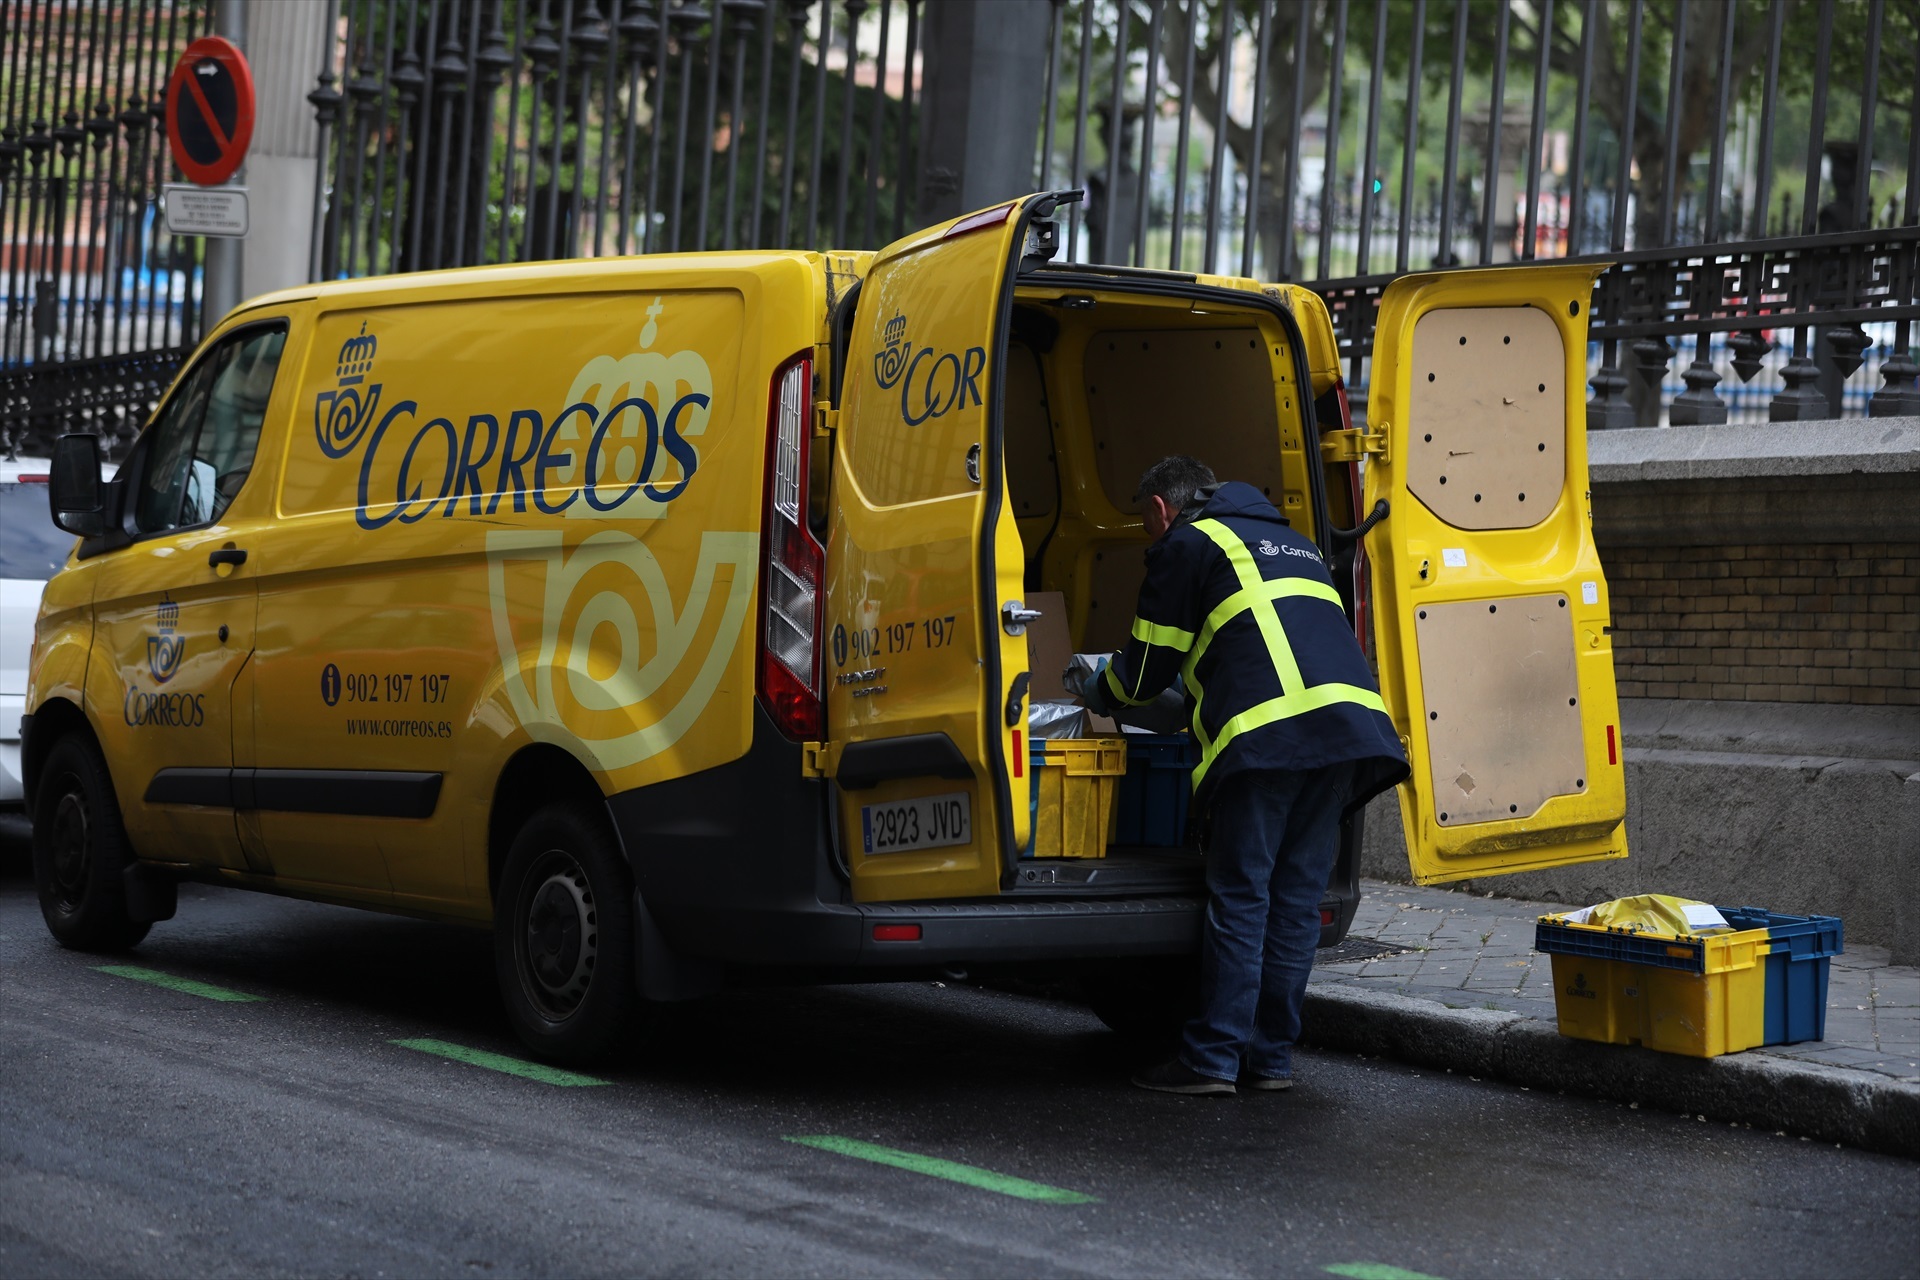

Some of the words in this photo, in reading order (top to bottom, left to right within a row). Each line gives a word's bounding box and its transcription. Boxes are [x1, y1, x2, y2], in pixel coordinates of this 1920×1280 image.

[355, 393, 711, 530] CORREOS
[851, 627, 881, 660] 902
[885, 622, 915, 654] 197
[923, 616, 956, 649] 197
[124, 685, 205, 728] CORREOS
[346, 673, 379, 702] 902
[384, 673, 413, 703] 197
[420, 673, 450, 704] 197
[347, 719, 452, 738] www.correos.es
[876, 805, 920, 848] 2923
[928, 800, 963, 841] JVD
